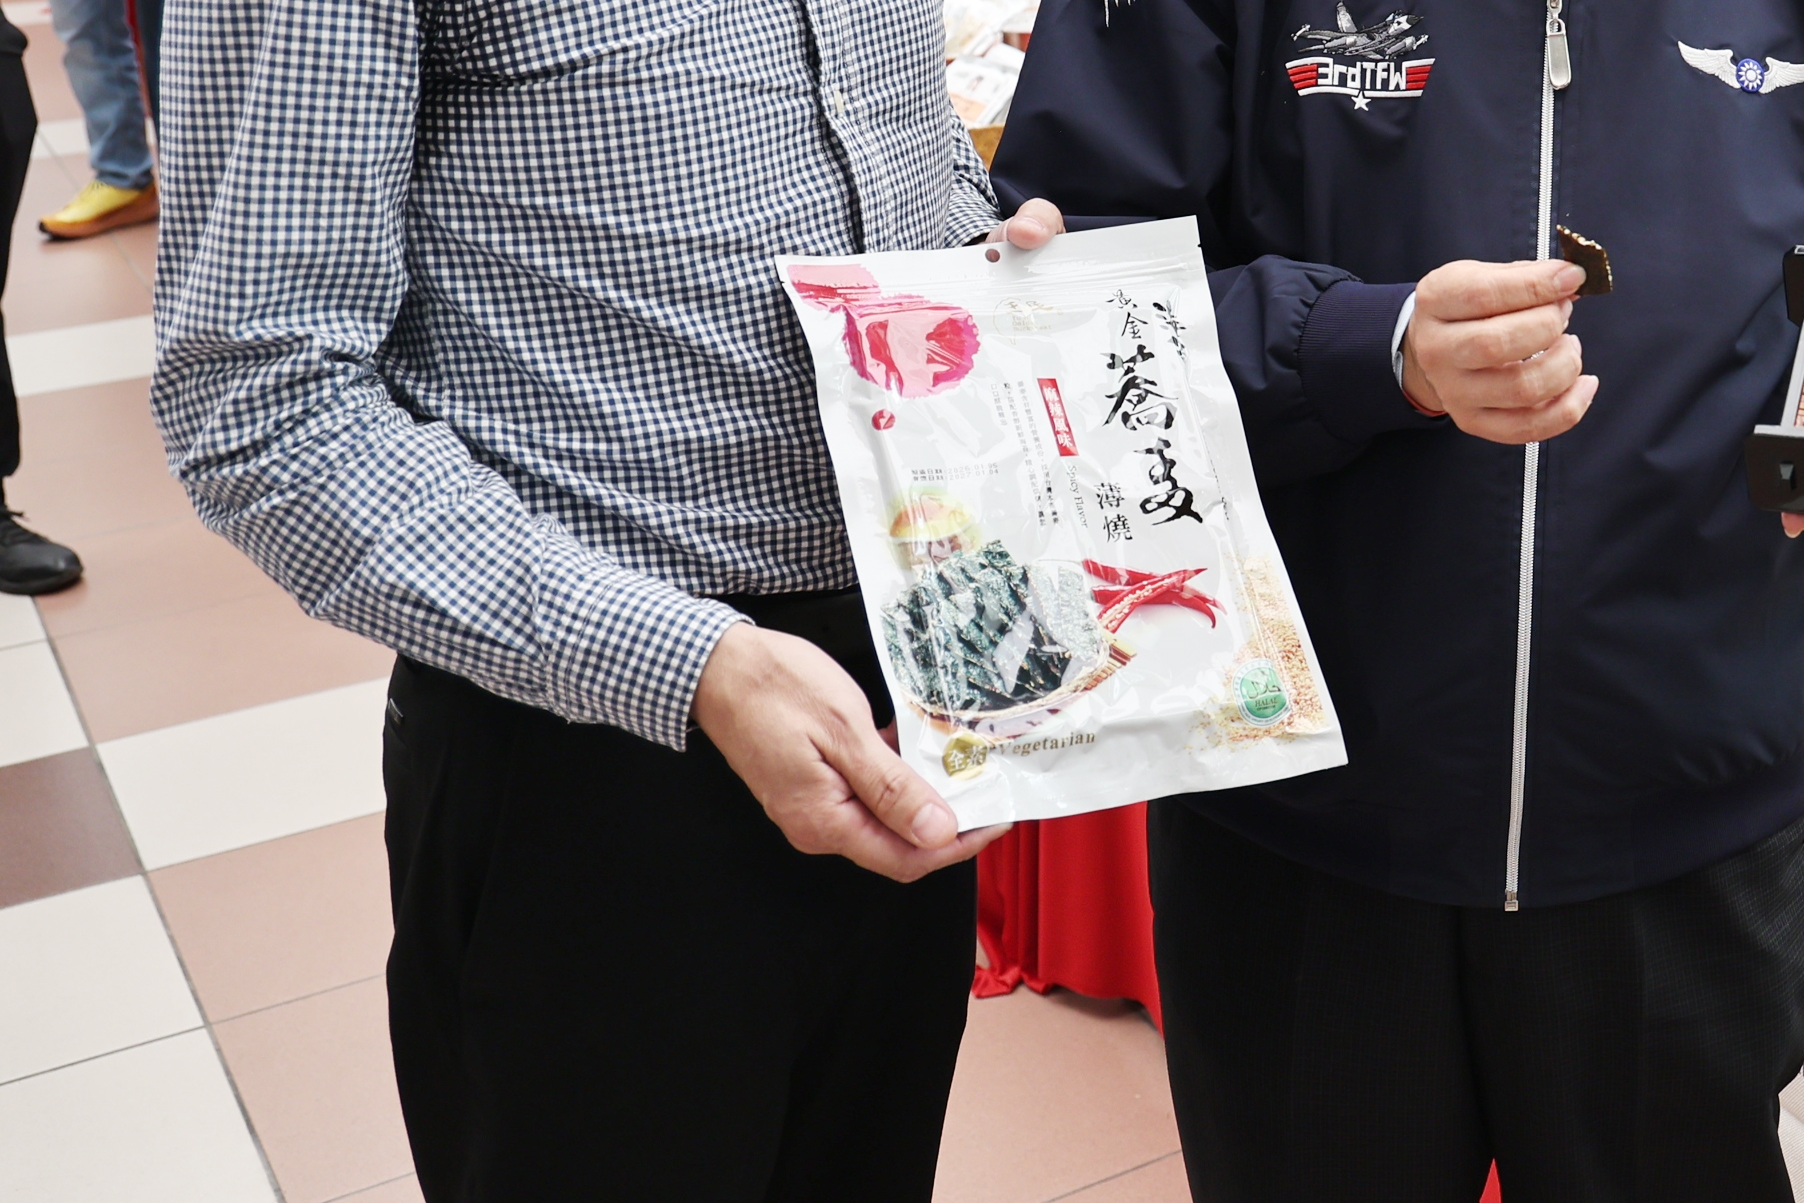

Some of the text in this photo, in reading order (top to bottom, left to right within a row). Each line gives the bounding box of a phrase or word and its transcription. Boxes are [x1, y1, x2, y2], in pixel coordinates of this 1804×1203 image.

[1042, 386, 1074, 448] 麻辣風味
[1066, 465, 1089, 529] Spicy Flavor
[1094, 482, 1133, 543] 薄燒
[1255, 697, 1278, 707] HALAL
[948, 745, 988, 770] 全素
[997, 731, 1096, 757] Vegetarian
